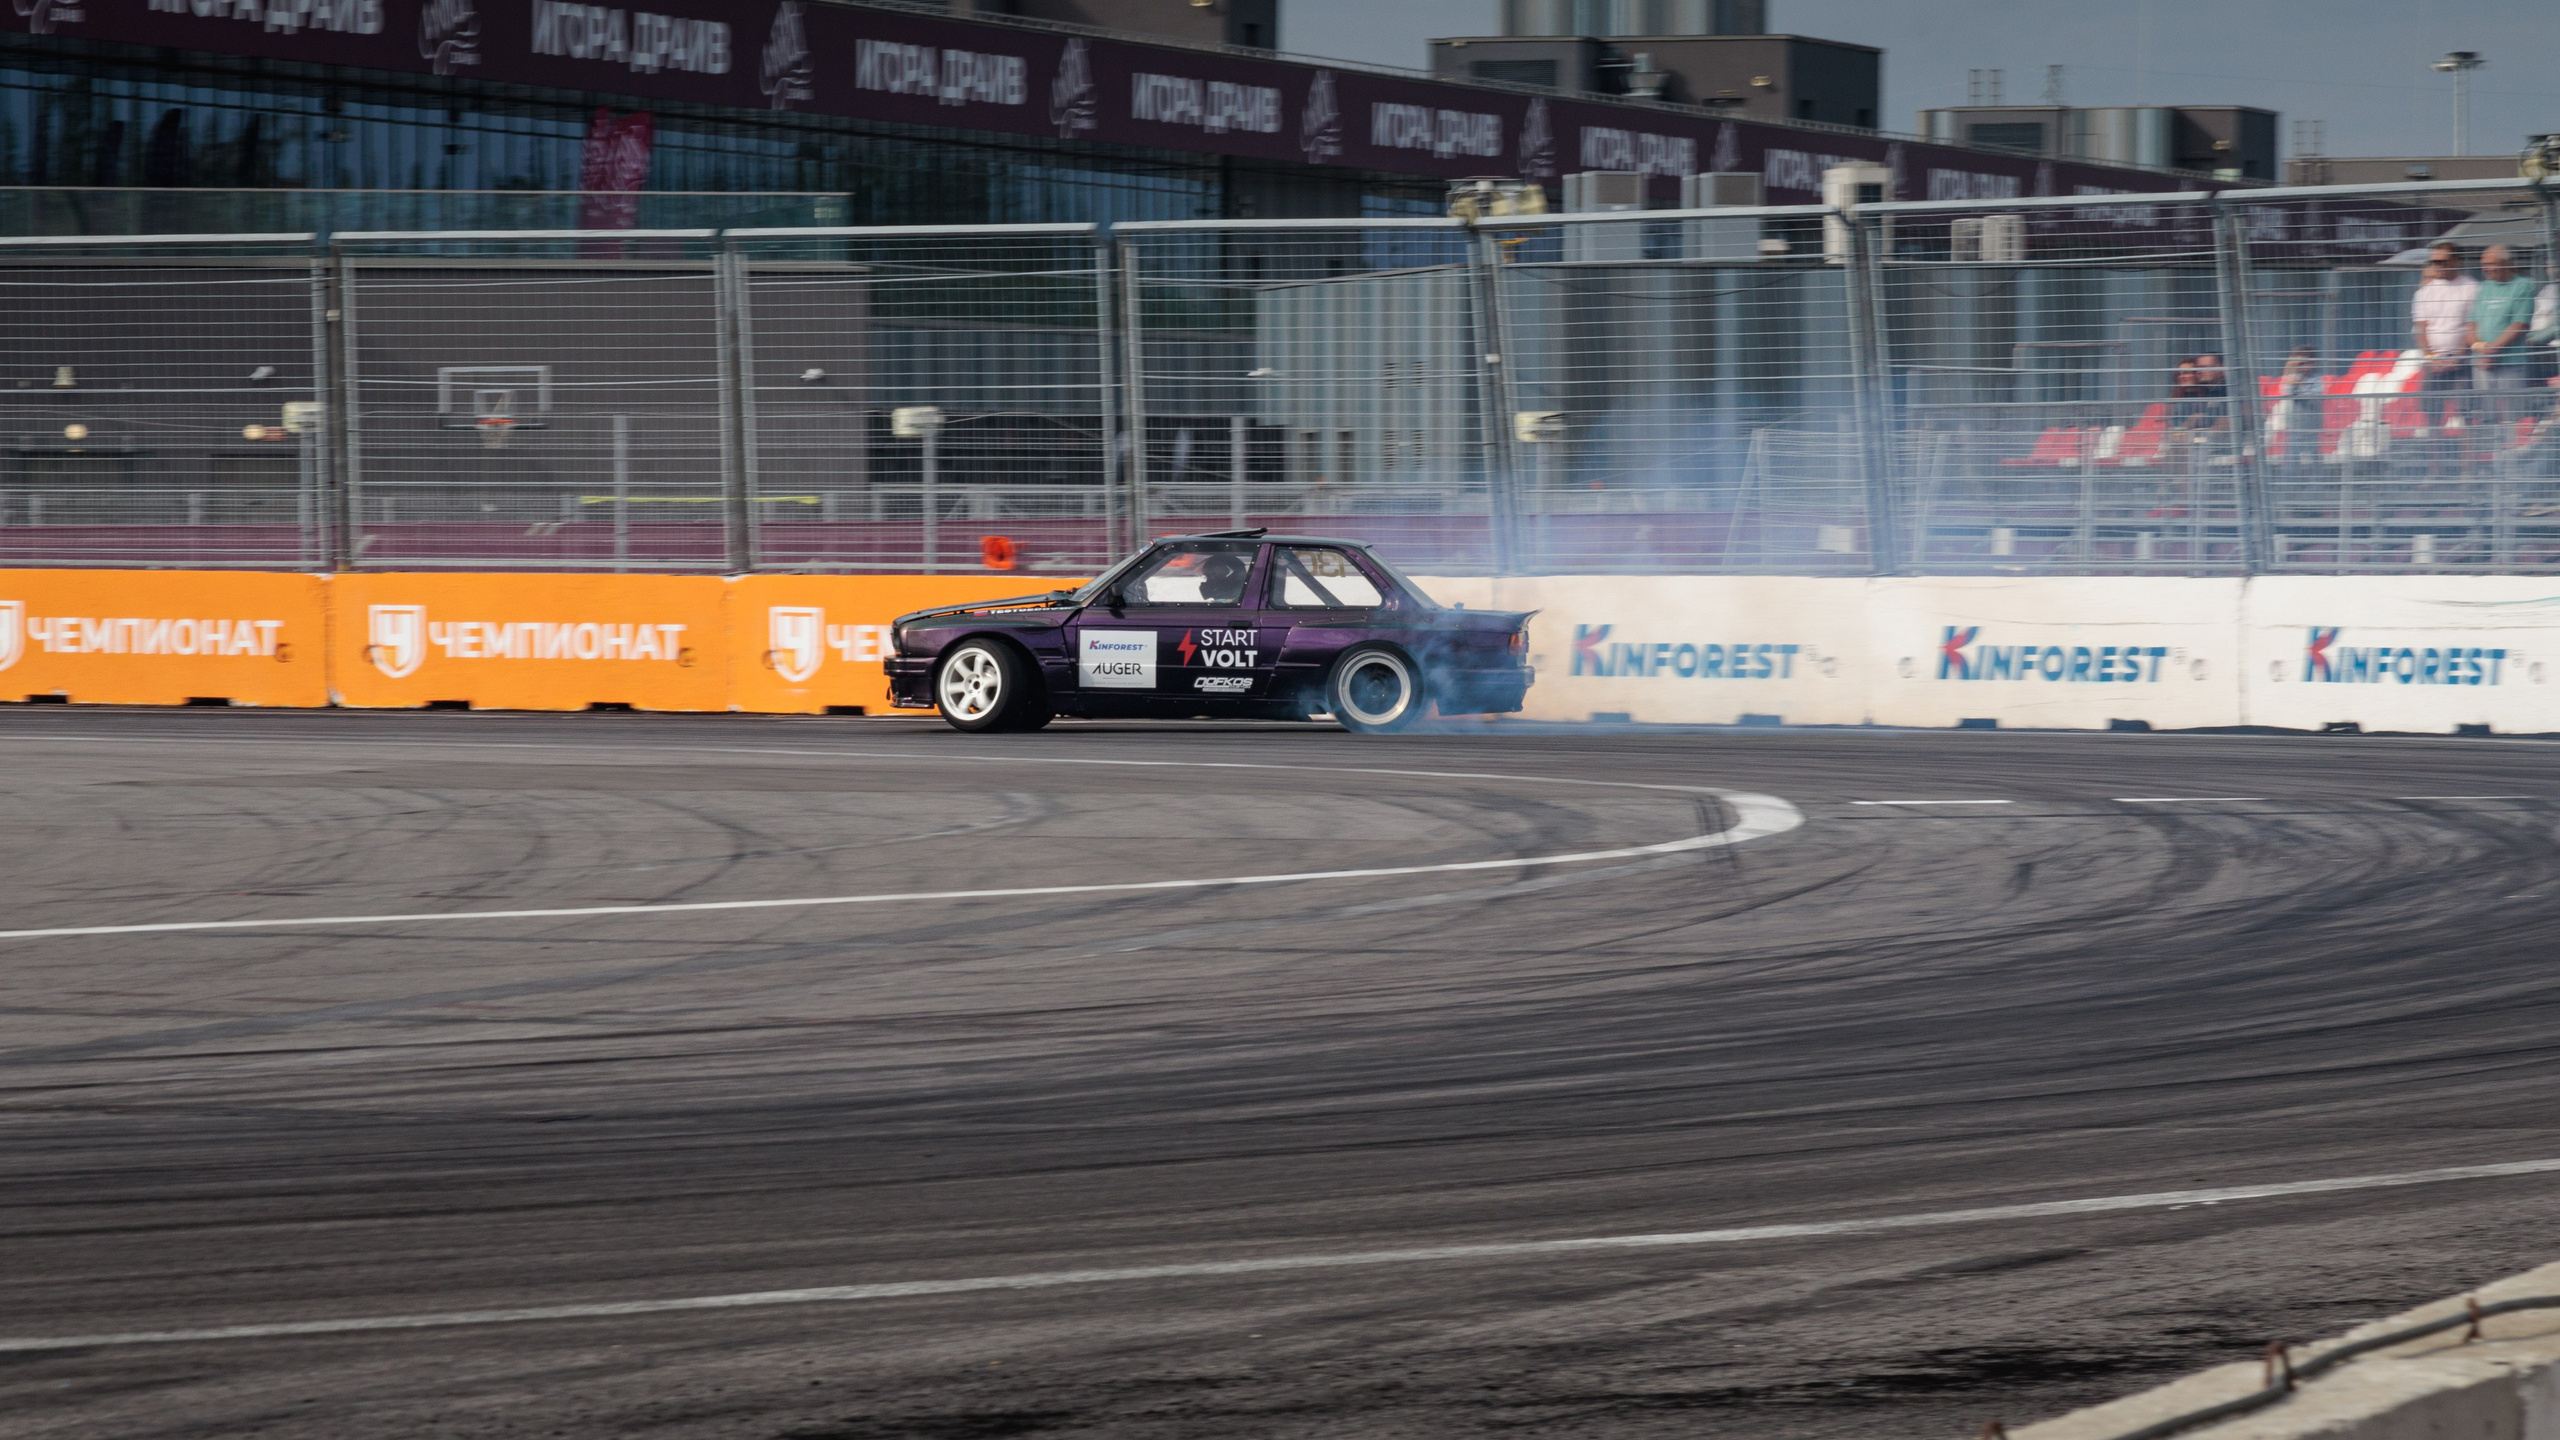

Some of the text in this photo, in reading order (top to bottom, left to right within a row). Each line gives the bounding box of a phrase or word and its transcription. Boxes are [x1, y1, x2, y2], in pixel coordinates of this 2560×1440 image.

[531, 0, 630, 62] ИГОРА
[27, 617, 285, 656] ЧЕМПИОНАТ
[428, 621, 687, 660] ЧЕМПИОНАТ
[1089, 640, 1144, 651] KINFOREST
[1201, 629, 1258, 646] START
[1569, 623, 1801, 679] KINFOREST
[1936, 625, 2169, 682] KINFOREST
[2302, 626, 2507, 685] KINFOREST
[1092, 662, 1143, 675] AUGER
[1201, 650, 1258, 667] VOLT
